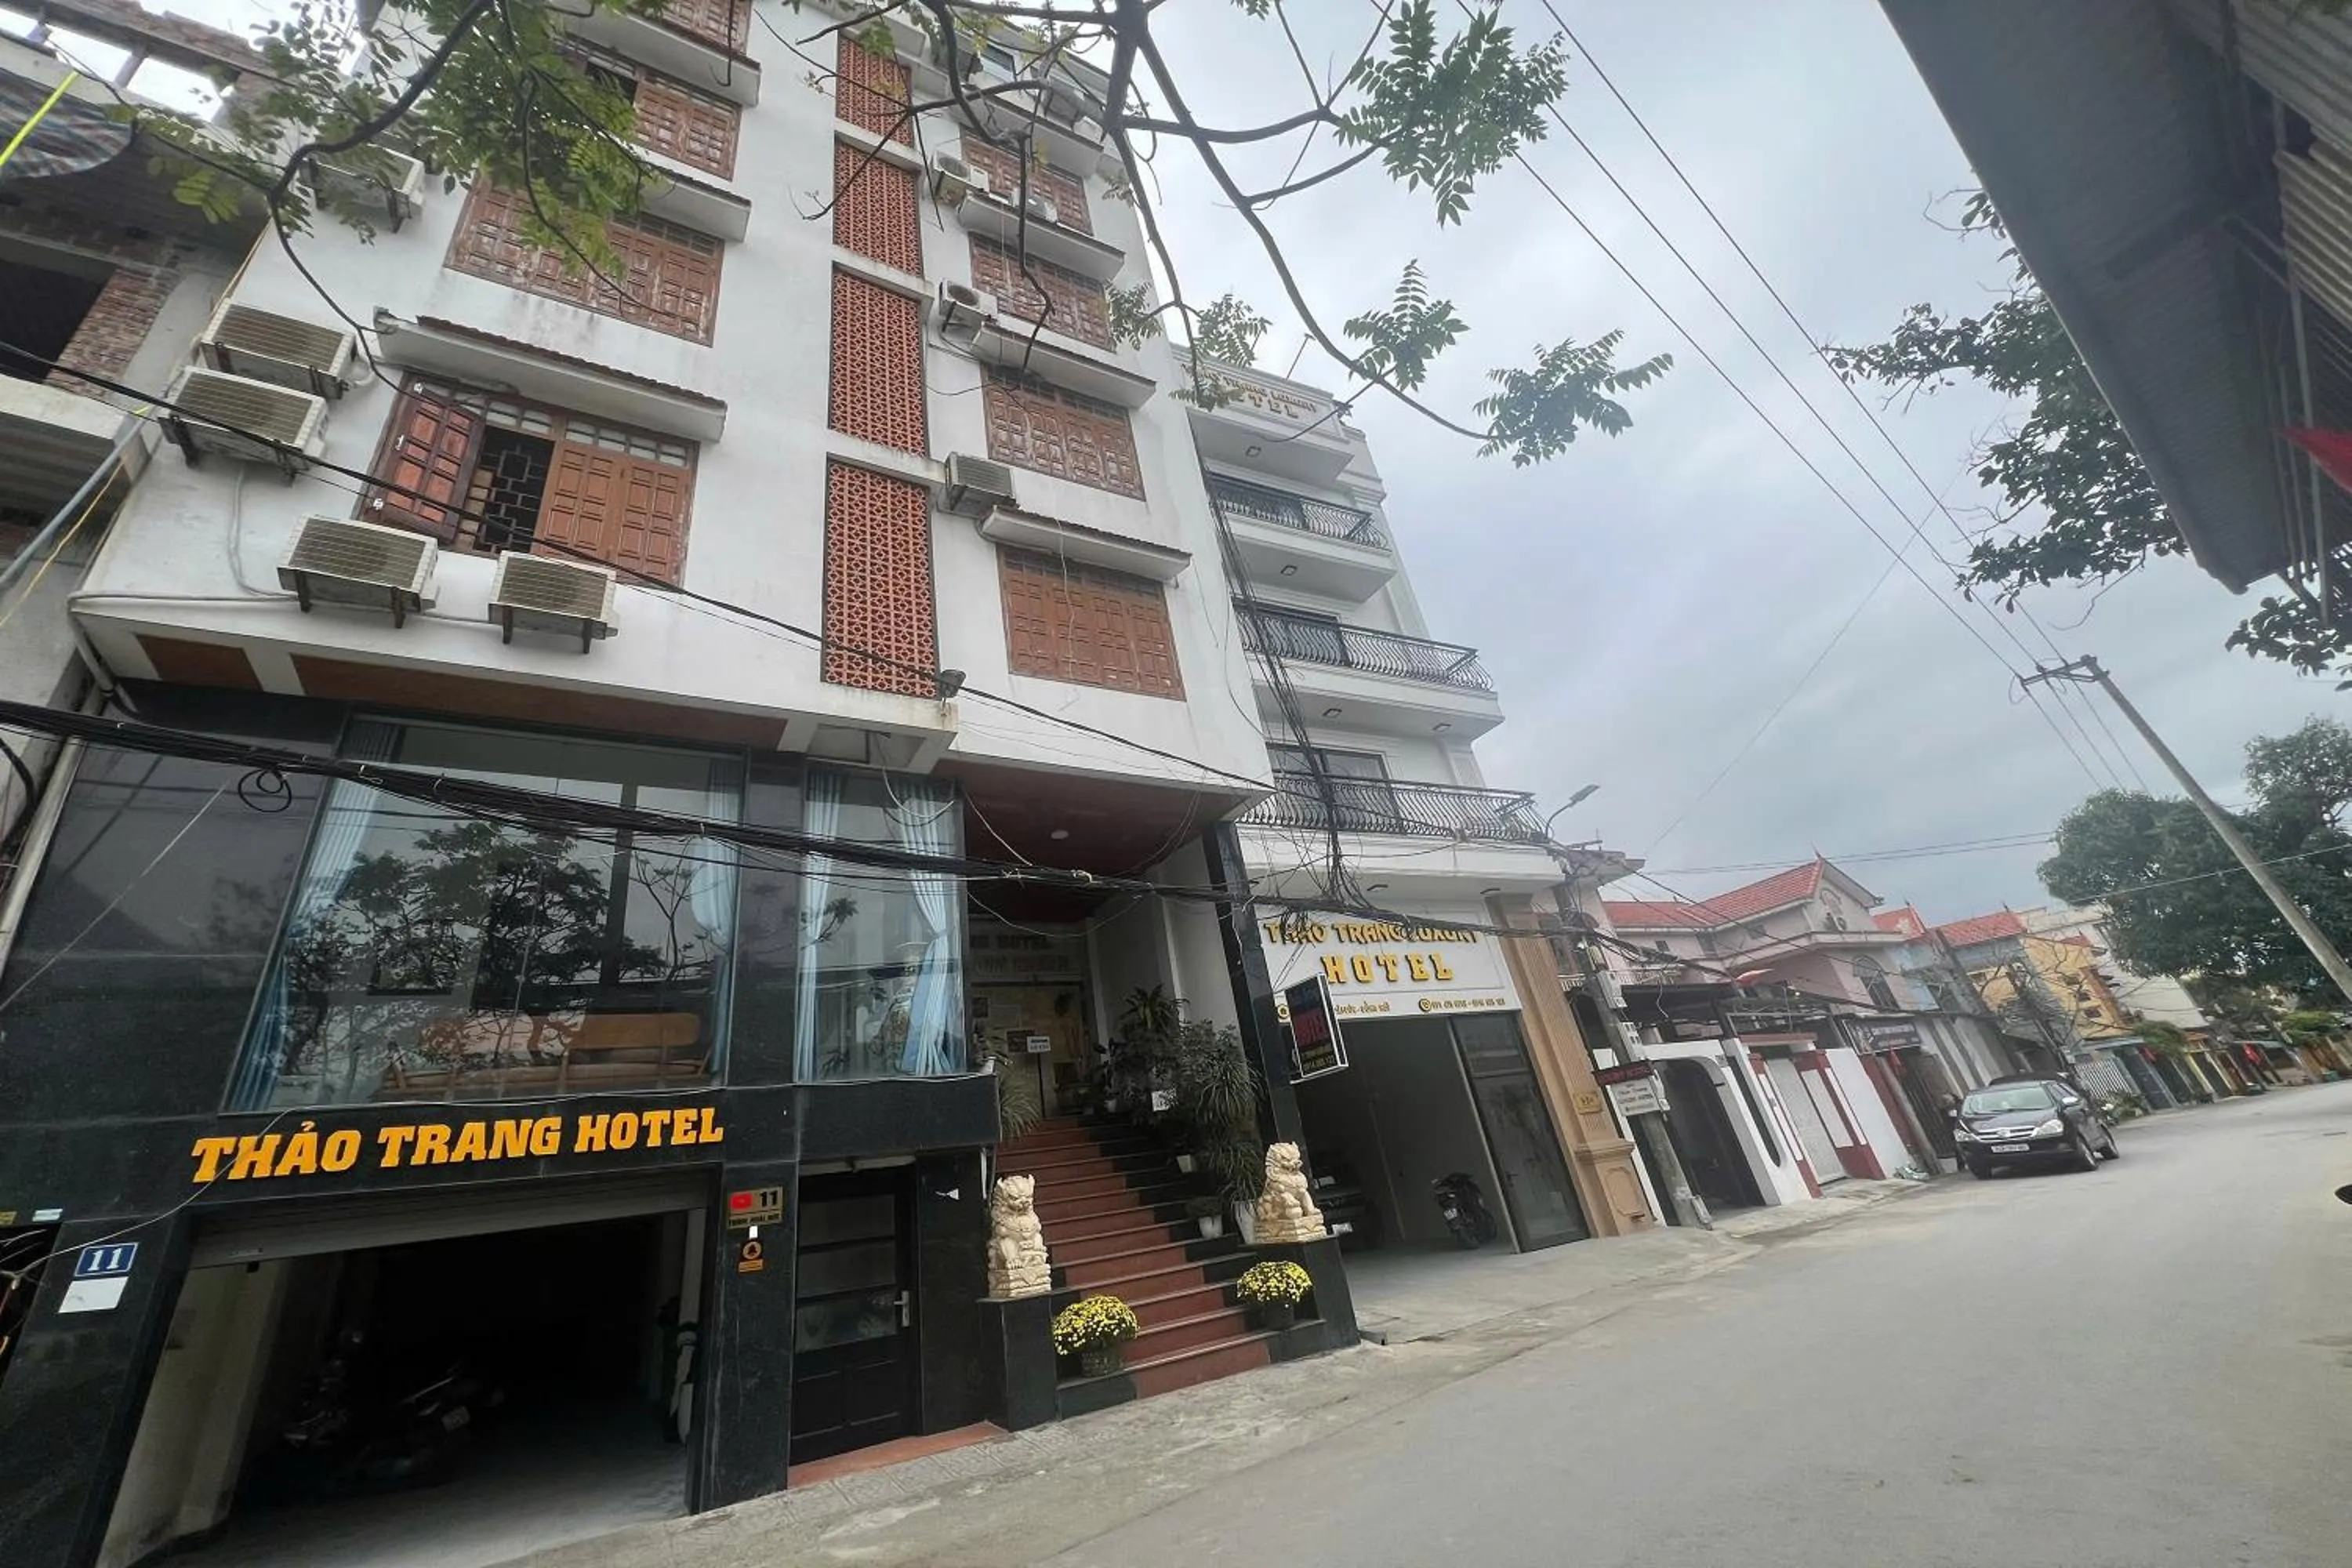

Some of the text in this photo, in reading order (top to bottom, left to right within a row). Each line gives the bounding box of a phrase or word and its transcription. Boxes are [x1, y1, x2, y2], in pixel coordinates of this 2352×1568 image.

[1321, 953, 1454, 984] HOTEL
[191, 1107, 724, 1183] THẢO TRANG HOTEL
[760, 1190, 779, 1207] 11
[87, 1247, 123, 1272] 11
